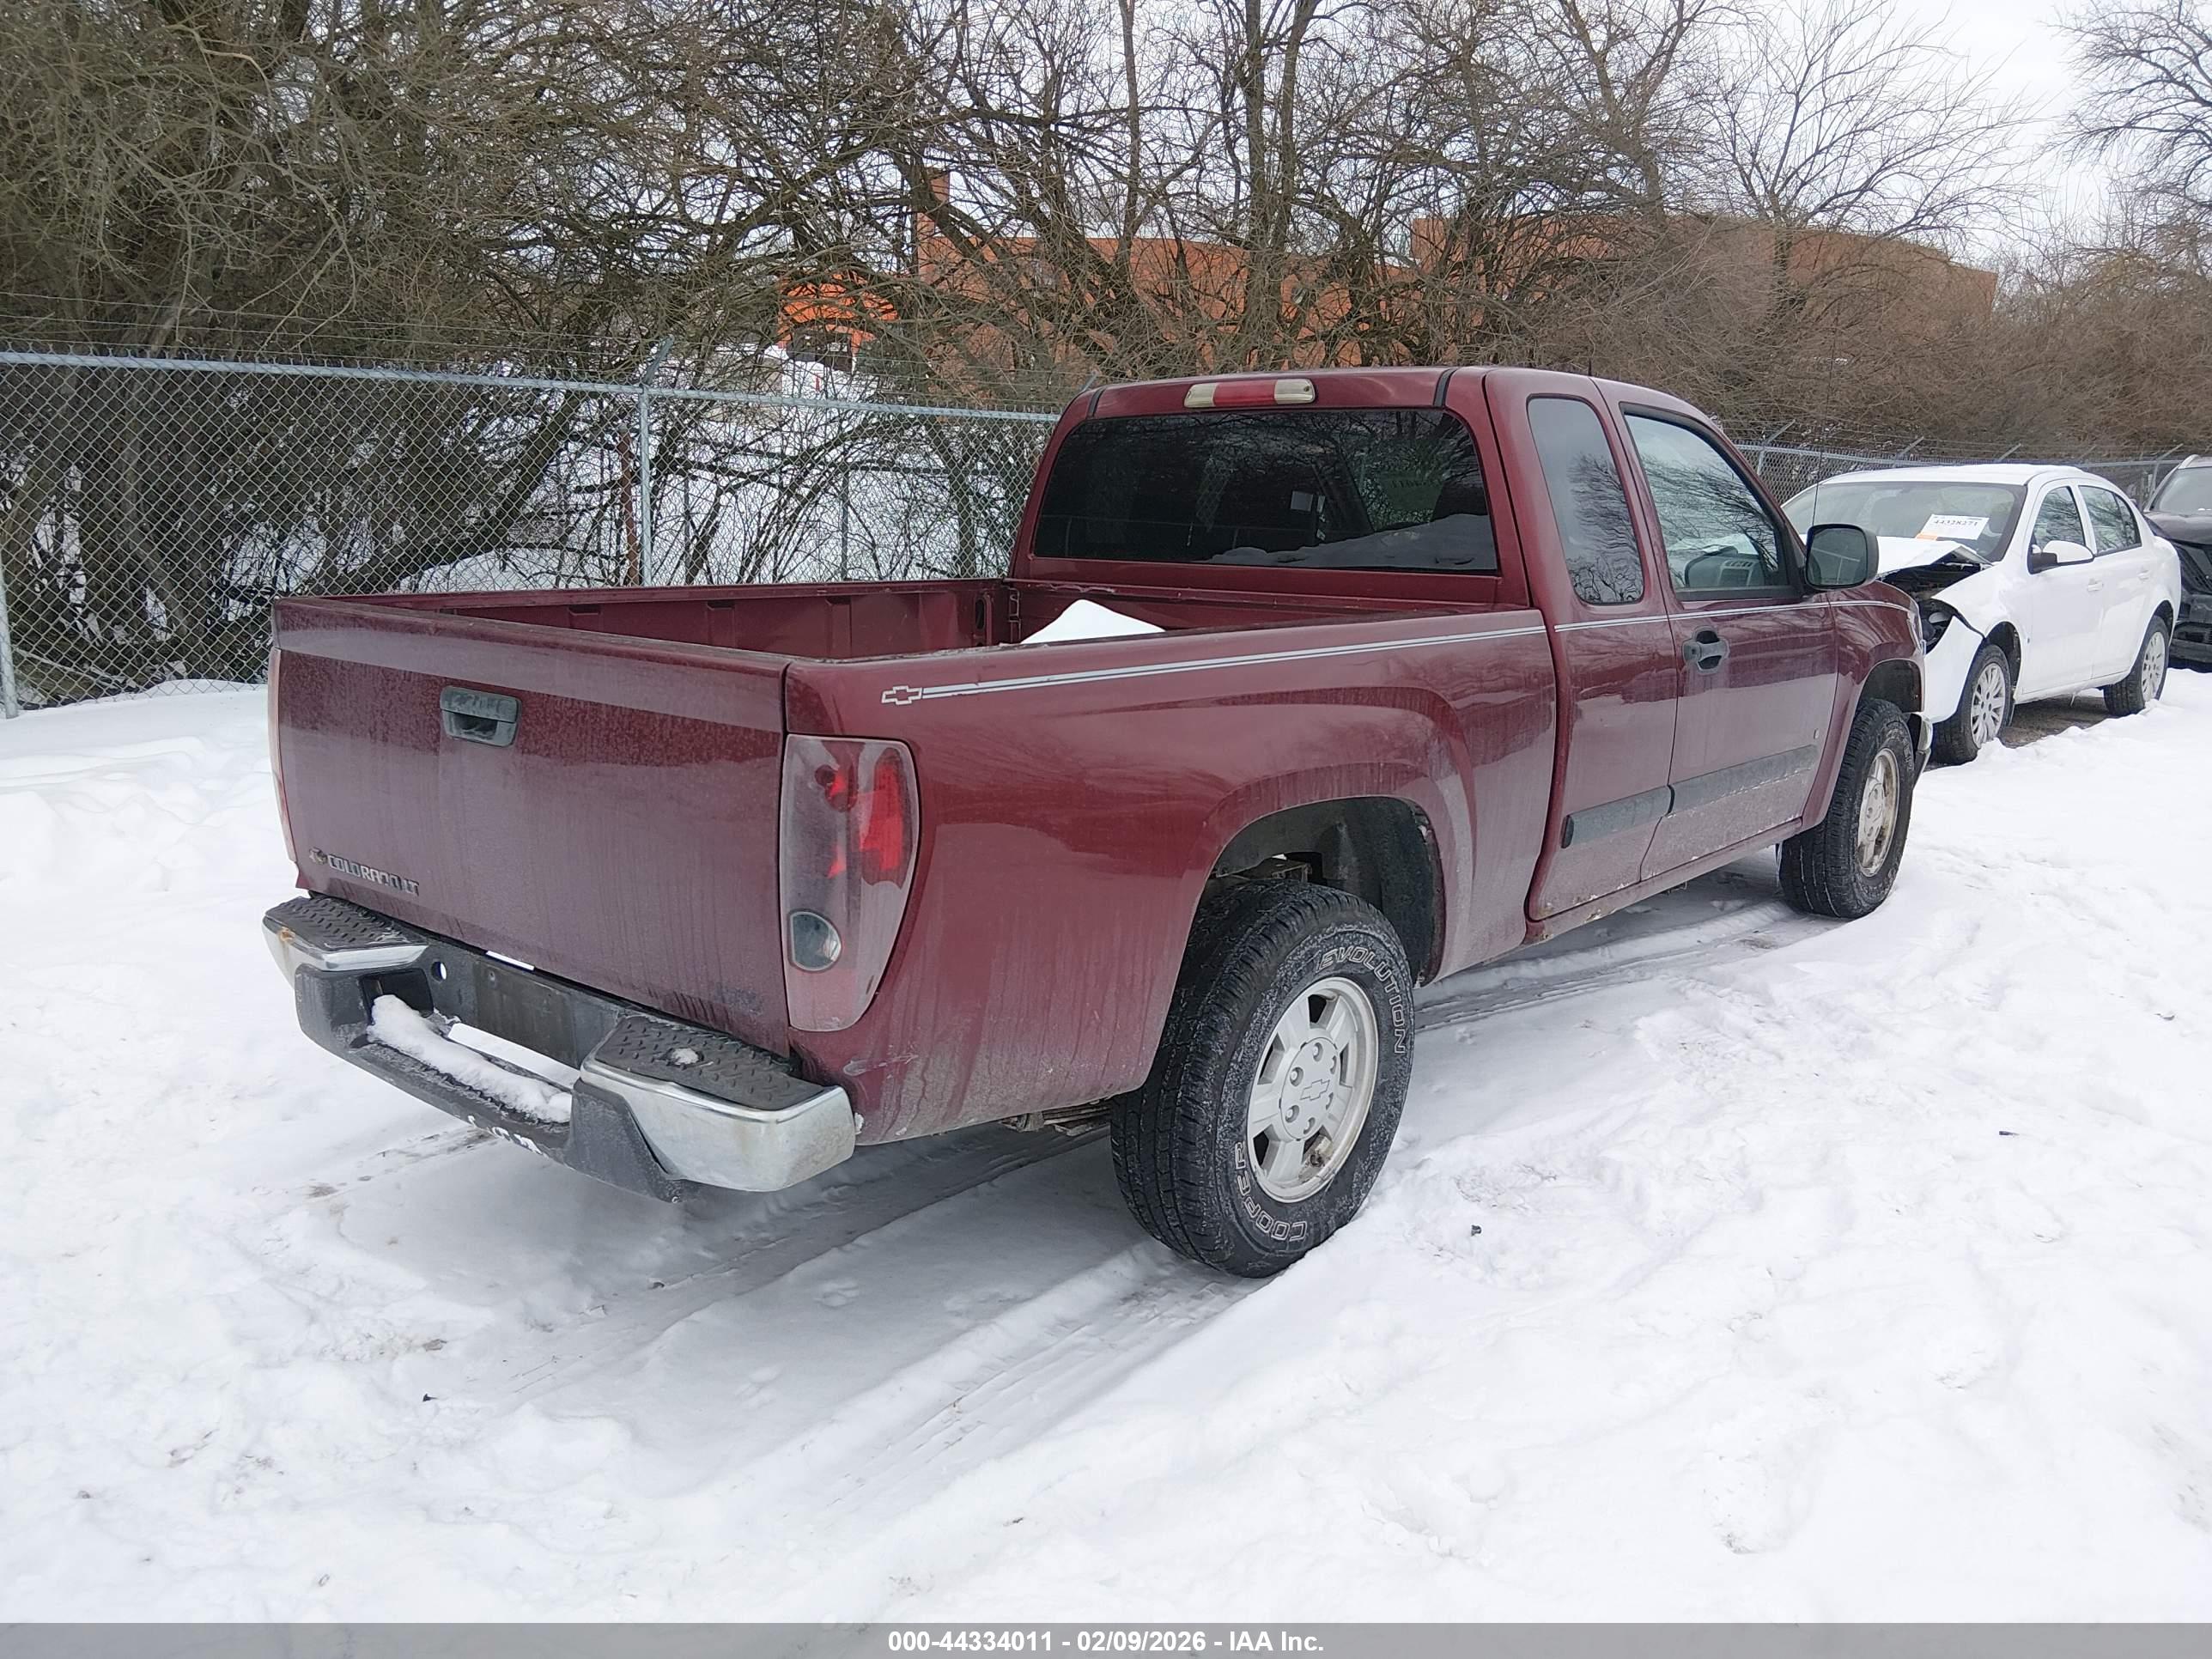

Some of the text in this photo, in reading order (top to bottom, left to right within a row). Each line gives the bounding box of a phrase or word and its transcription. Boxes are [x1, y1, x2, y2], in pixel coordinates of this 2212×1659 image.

[328, 854, 419, 896] COLORADO LT
[1316, 945, 1406, 1054] EVOLUTION
[1234, 1140, 1308, 1242] COOPER
